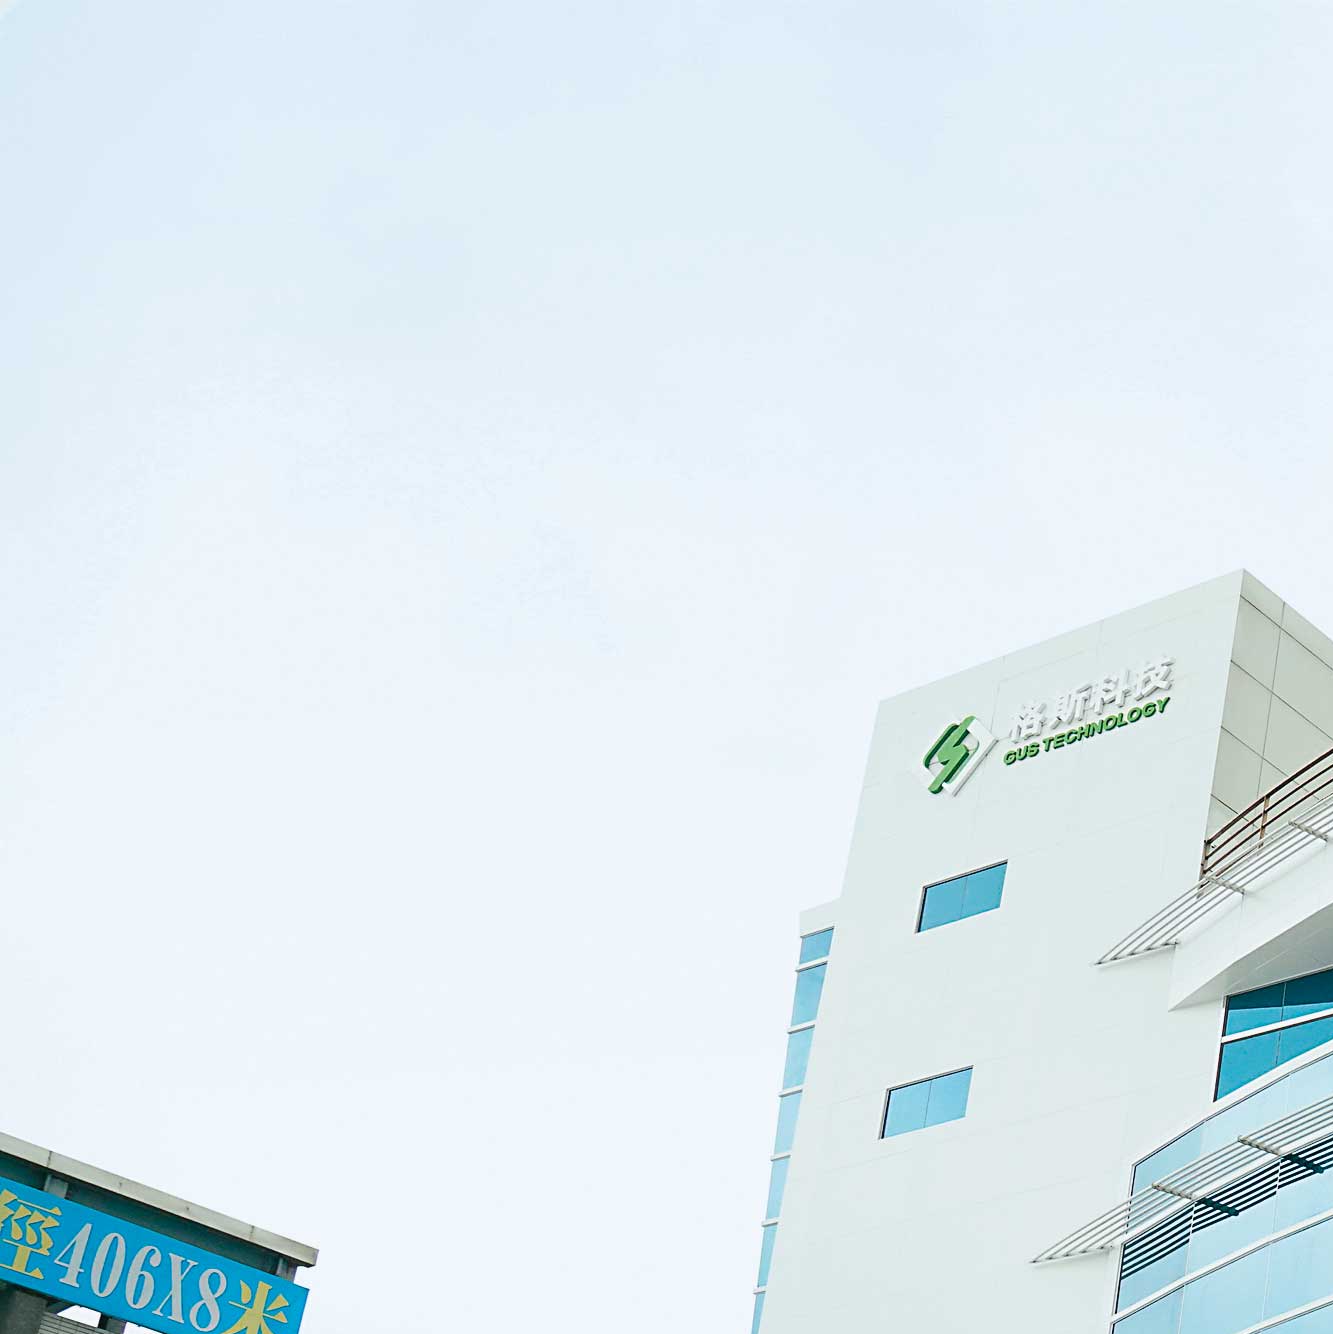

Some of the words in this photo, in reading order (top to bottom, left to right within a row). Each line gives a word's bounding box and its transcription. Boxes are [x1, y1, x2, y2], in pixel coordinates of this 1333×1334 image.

[1003, 741, 1039, 766] GUS
[1042, 696, 1171, 752] TECHNOLOGY
[1008, 657, 1176, 743] 格斯科技
